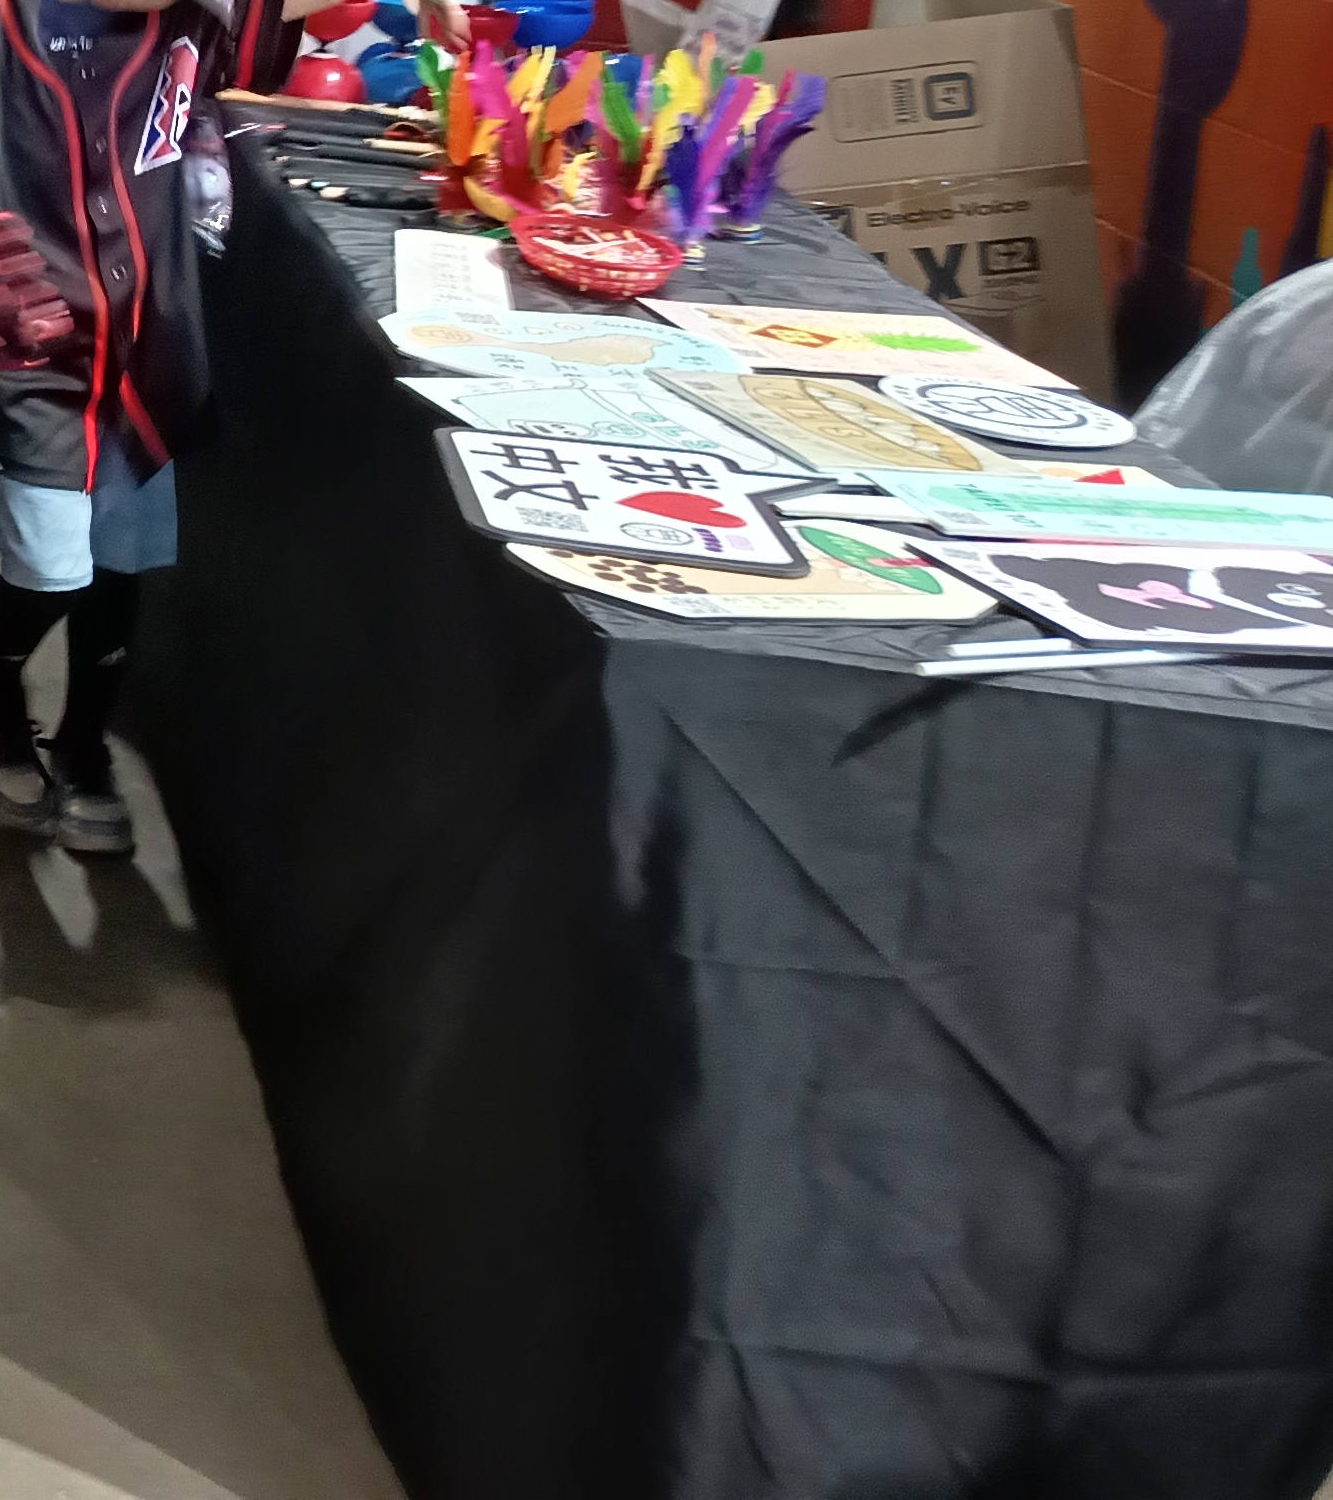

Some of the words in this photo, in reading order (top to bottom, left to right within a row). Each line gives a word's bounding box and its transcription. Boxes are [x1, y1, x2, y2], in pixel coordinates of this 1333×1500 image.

[867, 199, 1031, 228] Electro-Voice
[468, 441, 601, 512] 中文
[597, 453, 720, 491] 我
